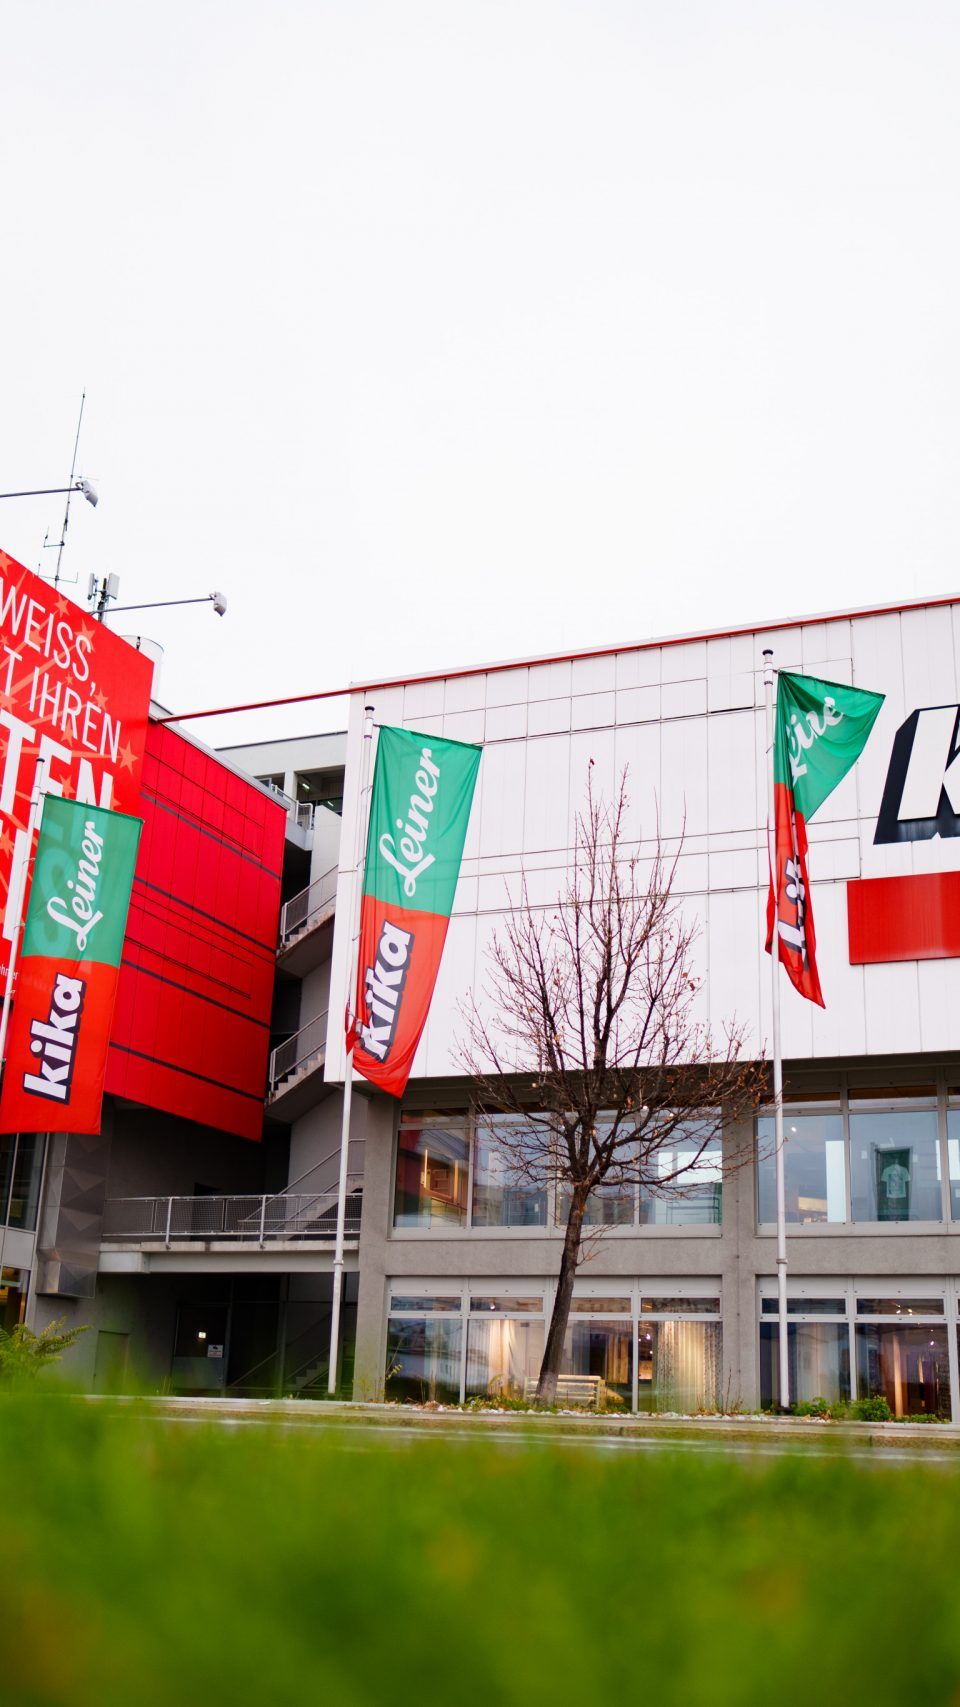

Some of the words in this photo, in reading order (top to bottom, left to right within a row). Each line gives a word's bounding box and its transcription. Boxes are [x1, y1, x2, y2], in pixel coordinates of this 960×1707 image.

[28, 665, 121, 764] IHREN
[46, 821, 104, 952] Leiner
[379, 747, 441, 897] Leiner
[23, 972, 87, 1105] kika
[358, 919, 415, 1064] kika
